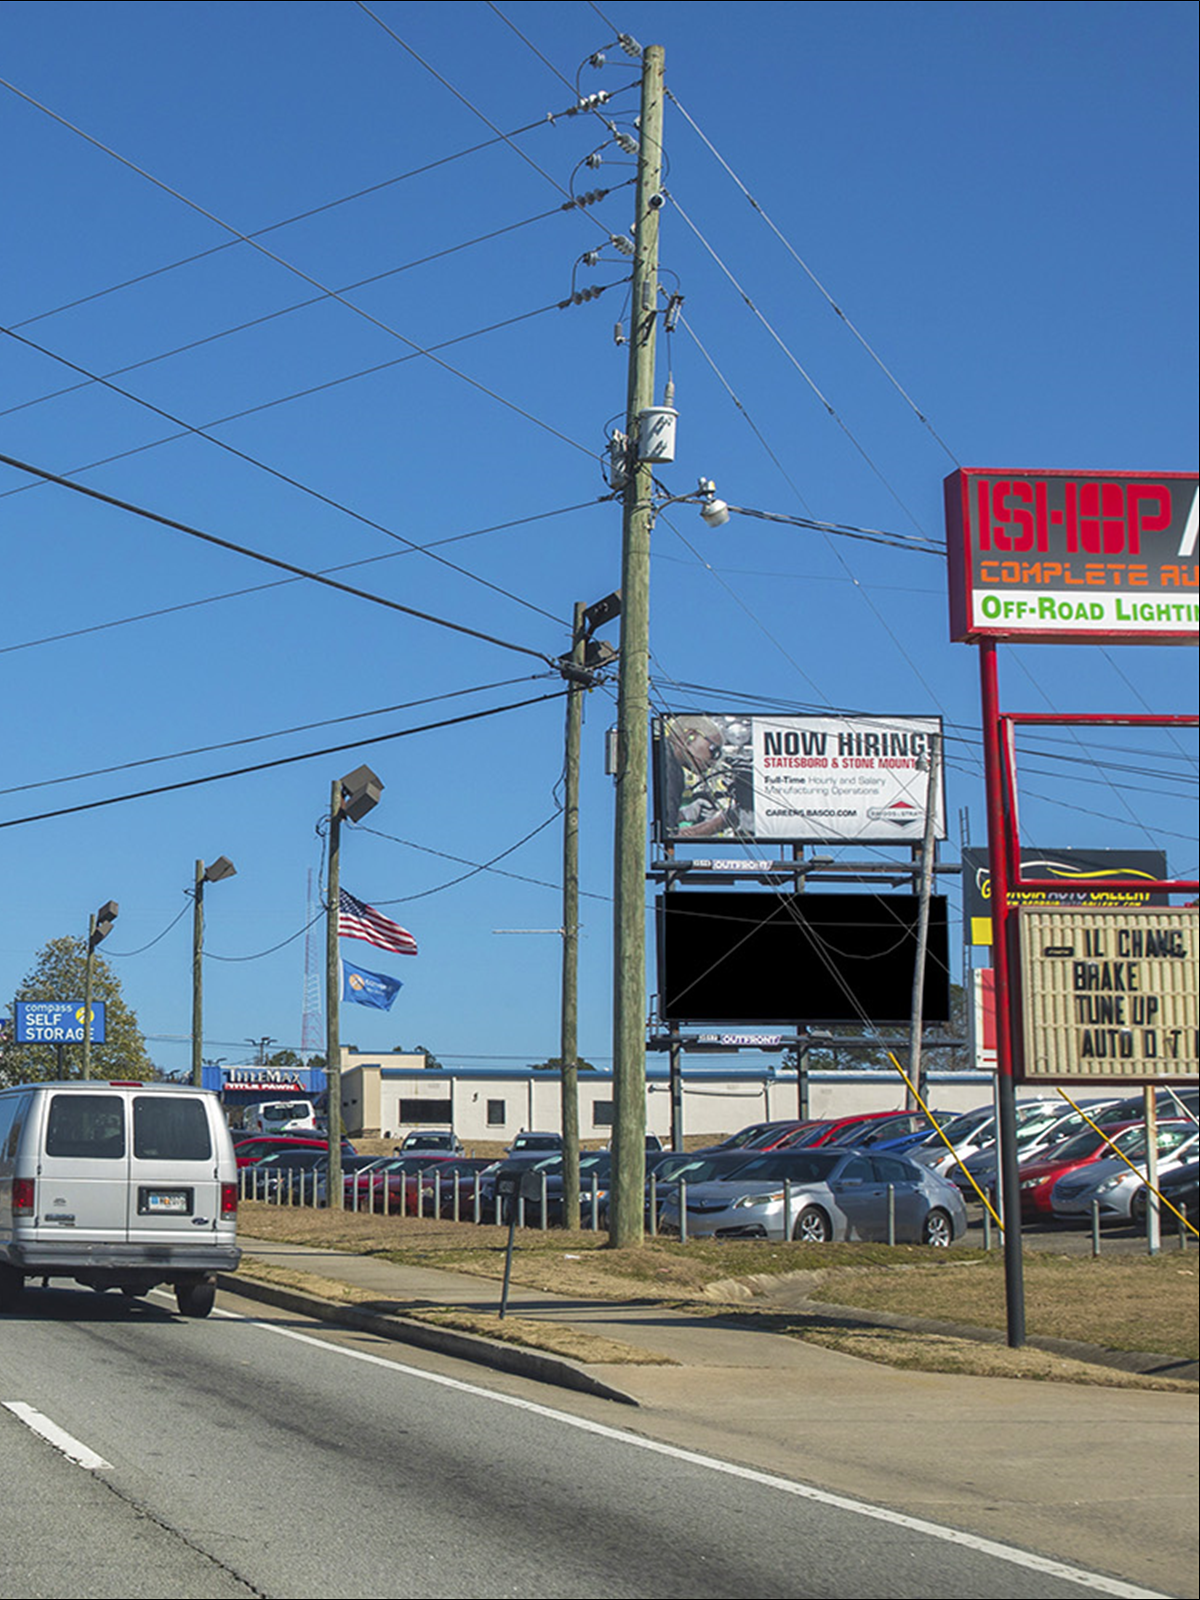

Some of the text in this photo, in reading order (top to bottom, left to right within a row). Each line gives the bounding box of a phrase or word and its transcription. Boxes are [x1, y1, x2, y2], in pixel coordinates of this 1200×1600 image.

[980, 560, 1149, 585] COMPLETE
[981, 595, 1105, 620] OFF-ROAD
[764, 731, 828, 756] NOW
[764, 757, 930, 770] STATESBORO & STONE MOUNT
[764, 776, 887, 787] Full-Time Hourly and Salary
[1074, 961, 1139, 991] BRAKE
[25, 1004, 74, 1014] compass
[25, 1014, 63, 1026] SELF
[1075, 995, 1159, 1025] TUNE UP
[1082, 1029, 1134, 1059] AUTO
[261, 1083, 295, 1091] PAWN
